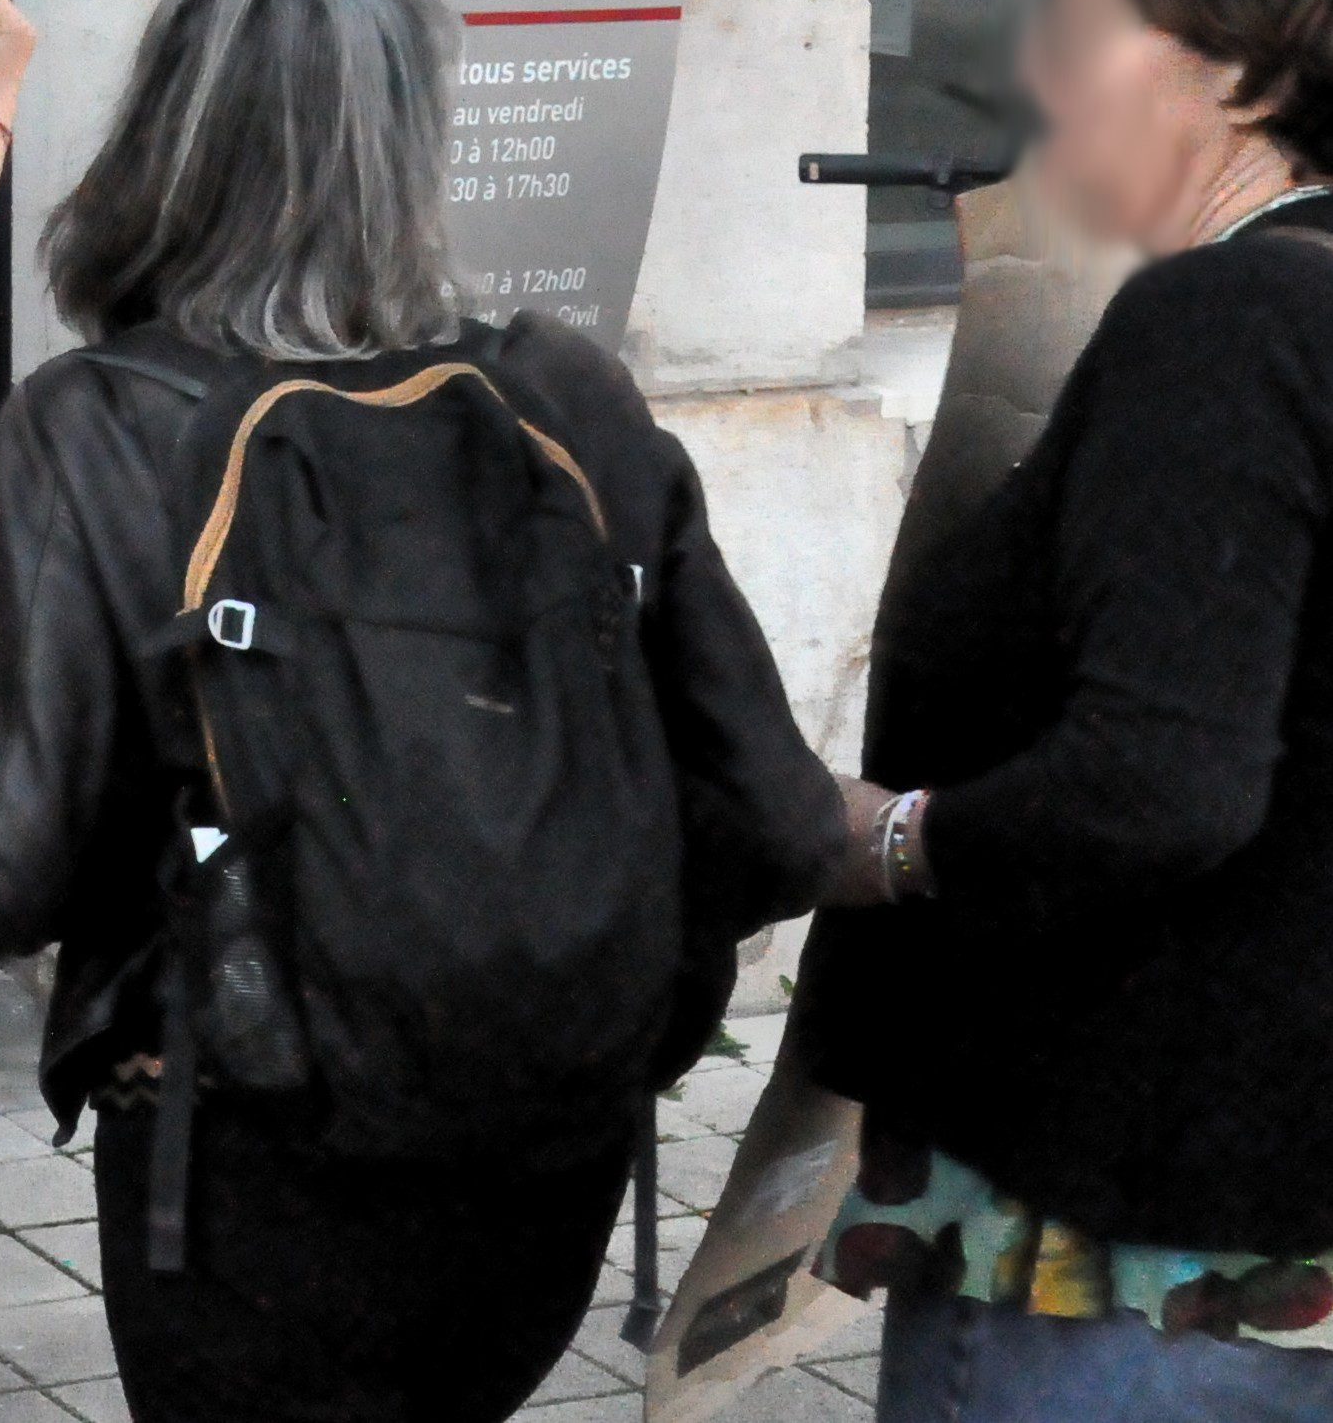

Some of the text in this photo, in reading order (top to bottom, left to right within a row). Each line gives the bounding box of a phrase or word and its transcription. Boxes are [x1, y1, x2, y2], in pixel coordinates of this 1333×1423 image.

[460, 54, 631, 85] tous services
[453, 97, 584, 125] au vendredi
[468, 137, 481, 163] à
[491, 136, 555, 162] 12h00
[450, 173, 571, 202] 30 à 17h30
[499, 270, 512, 295] à
[522, 267, 587, 293] 12h00
